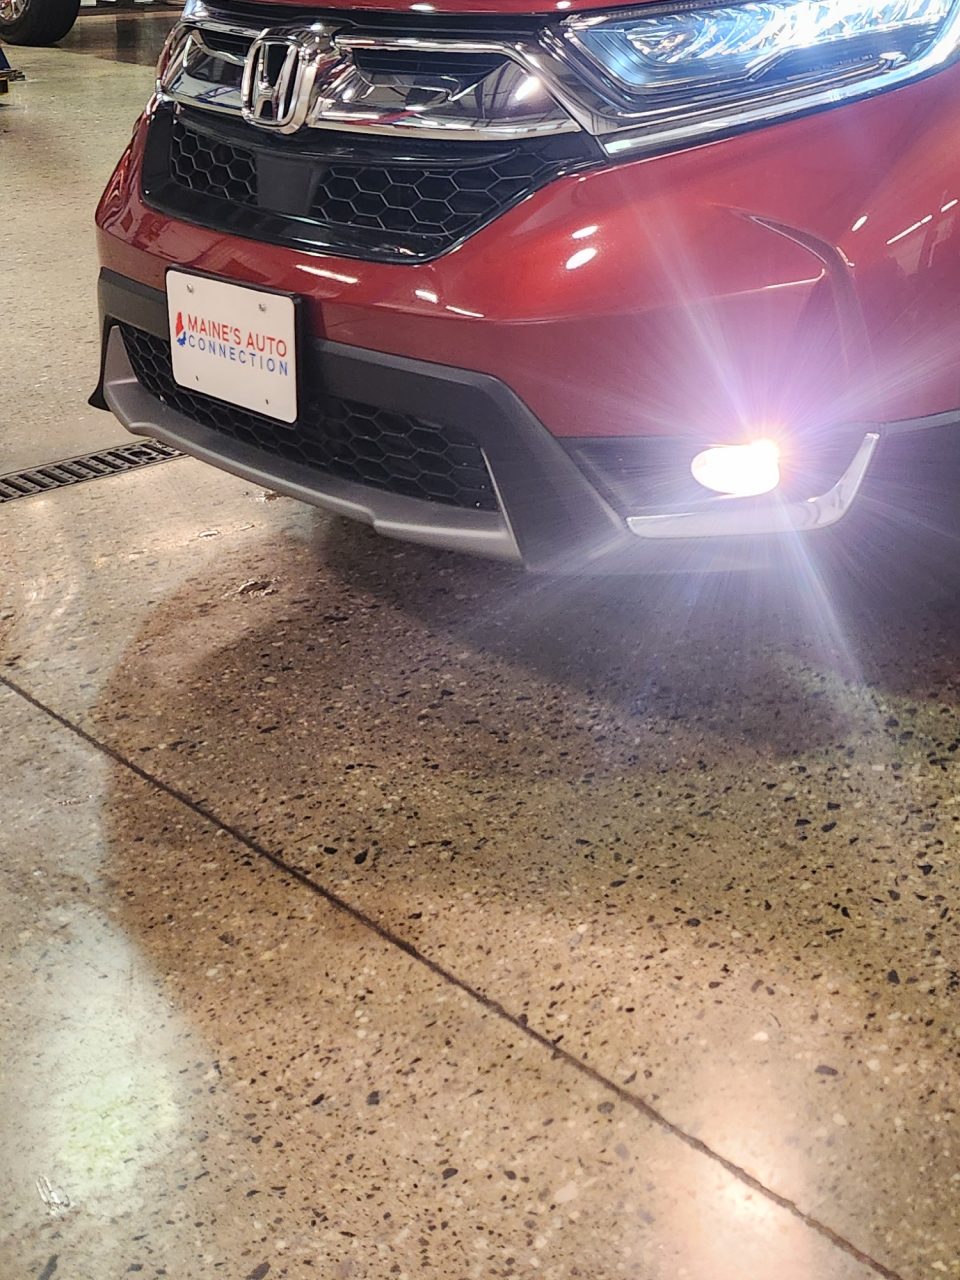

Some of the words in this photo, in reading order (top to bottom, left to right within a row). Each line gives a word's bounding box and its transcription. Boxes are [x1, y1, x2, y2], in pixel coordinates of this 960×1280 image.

[188, 314, 242, 345] MAINE'S
[247, 332, 287, 357] AUTO
[188, 335, 289, 376] CONNECTION
